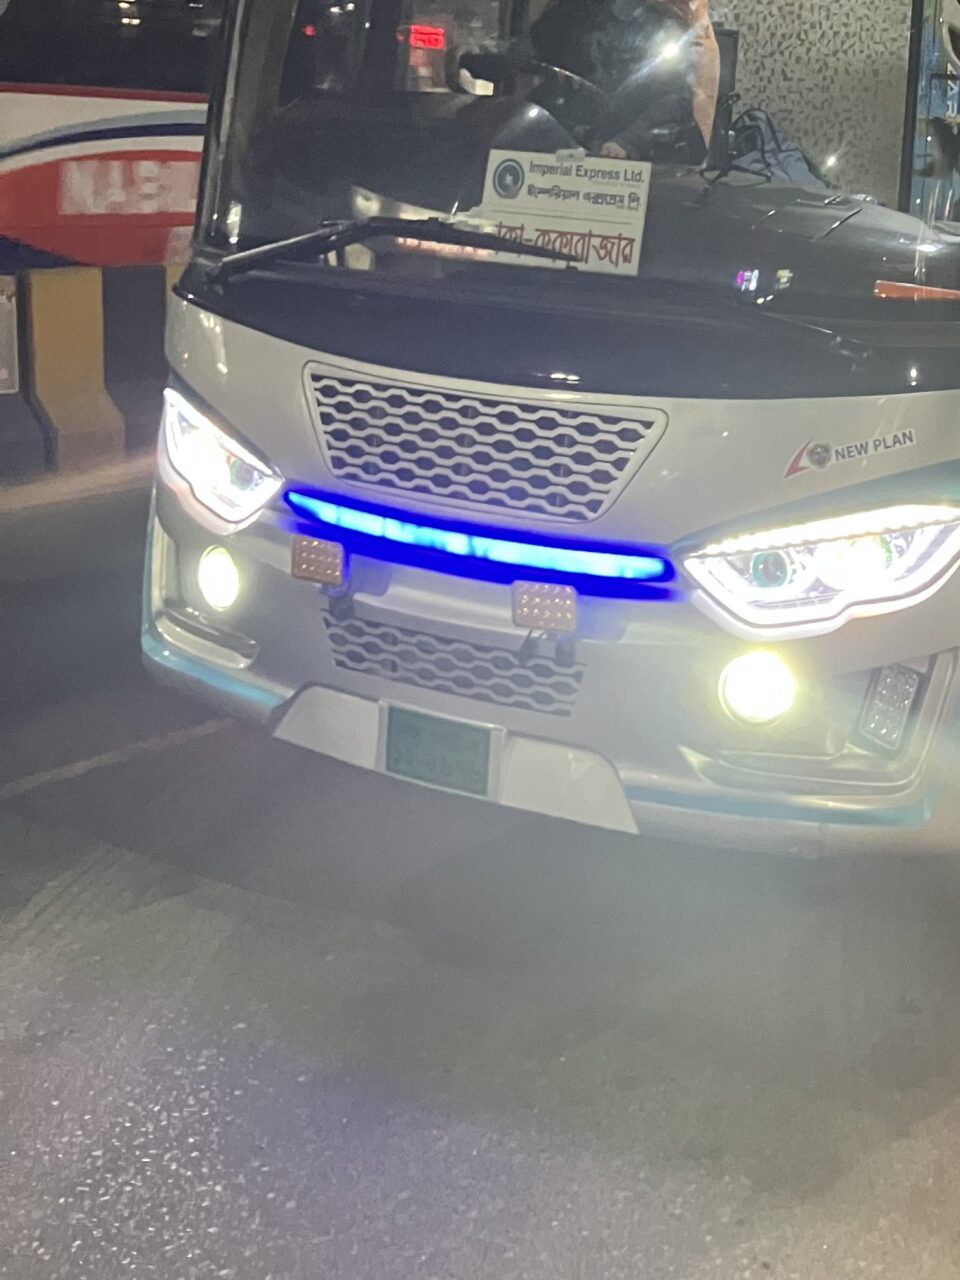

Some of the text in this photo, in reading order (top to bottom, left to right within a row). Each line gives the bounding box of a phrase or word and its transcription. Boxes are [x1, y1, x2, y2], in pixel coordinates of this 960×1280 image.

[529, 160, 645, 183] Imperial Express Ltd.
[834, 430, 914, 462] NEW PLAN
